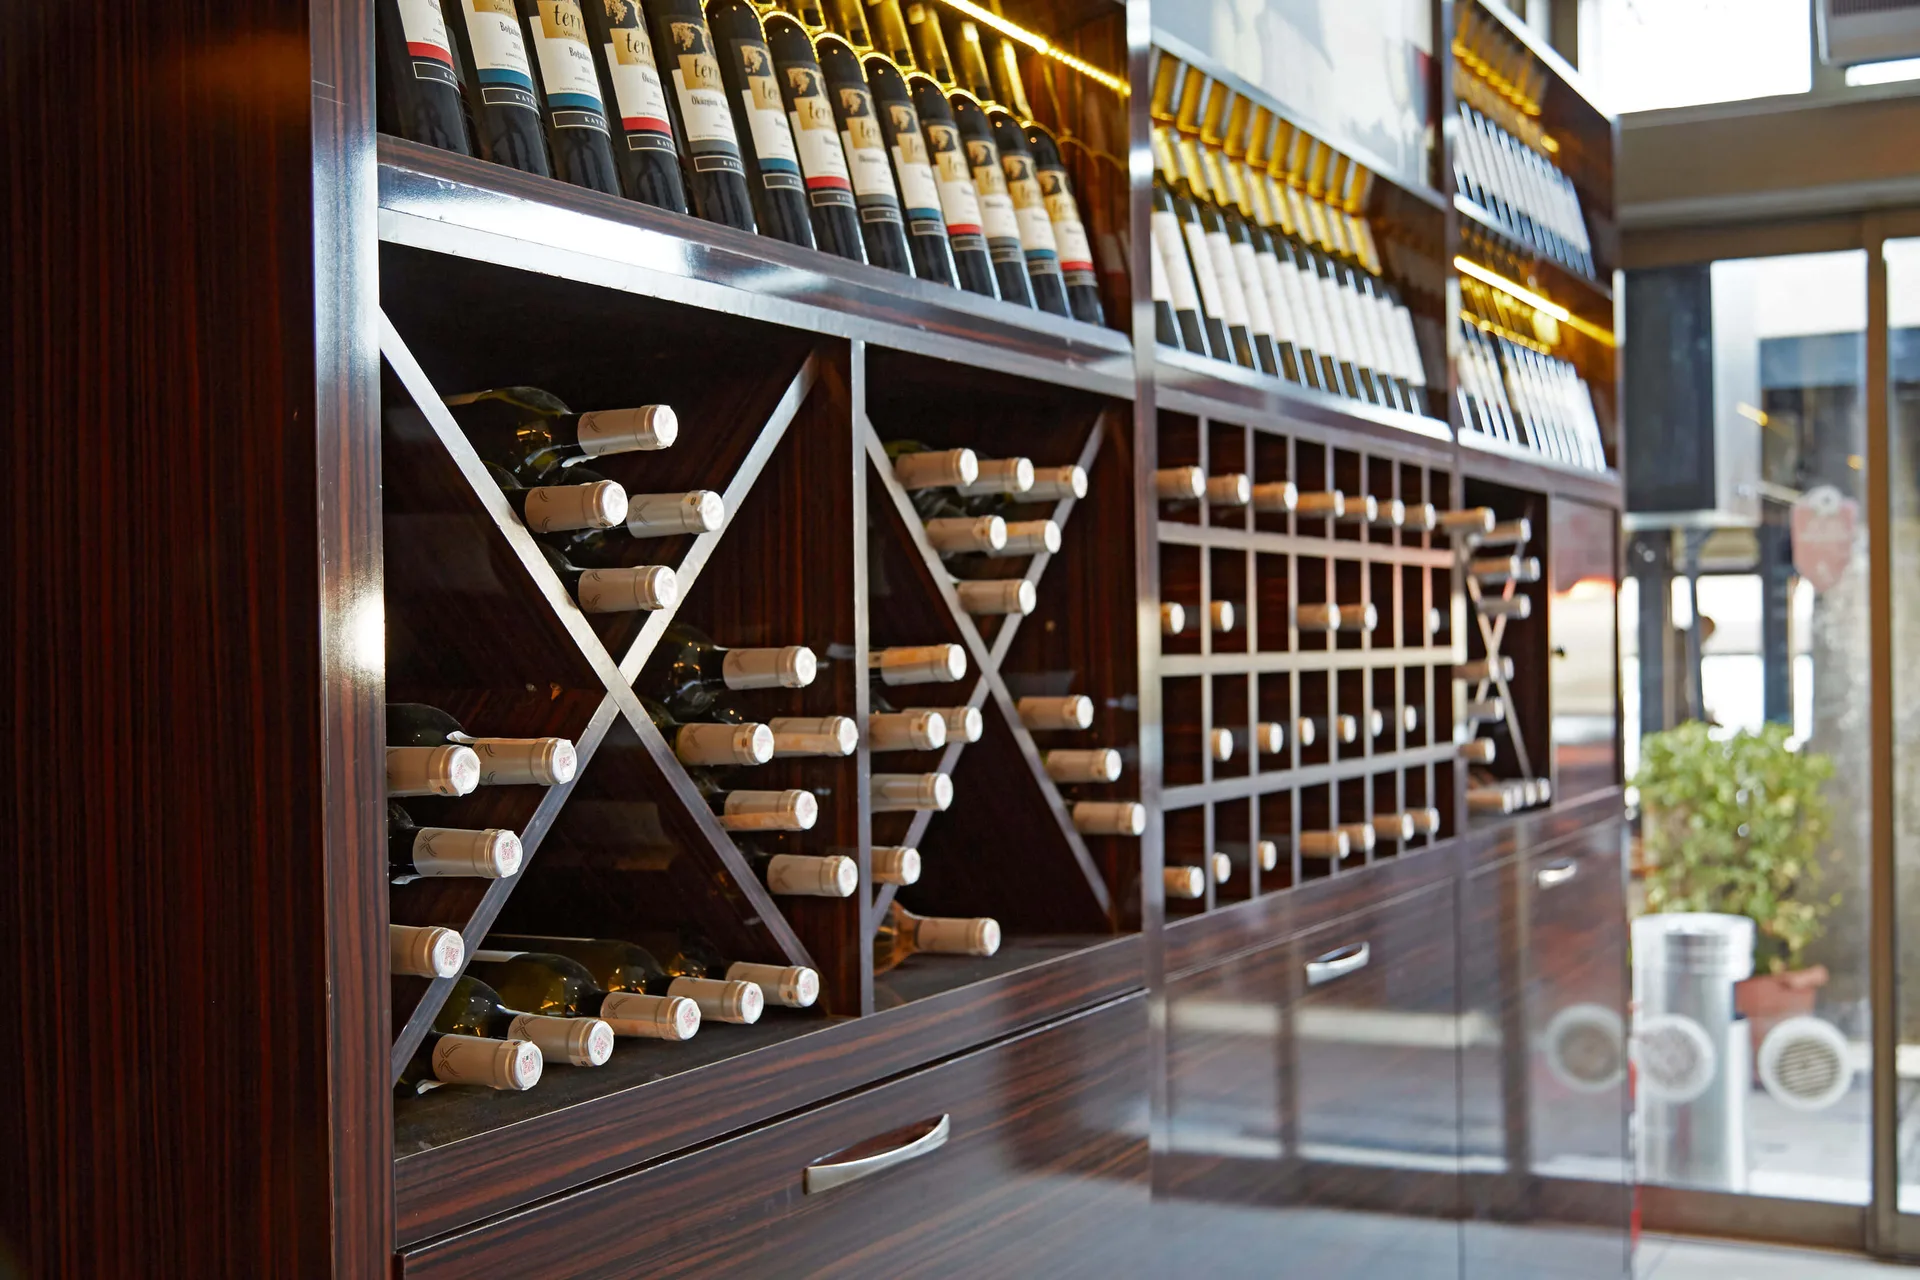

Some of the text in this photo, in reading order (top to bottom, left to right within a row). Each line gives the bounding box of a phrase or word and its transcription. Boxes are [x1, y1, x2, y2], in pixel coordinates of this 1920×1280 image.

[553, 4, 583, 31] terr
[626, 32, 652, 57] terr
[694, 58, 717, 79] terr
